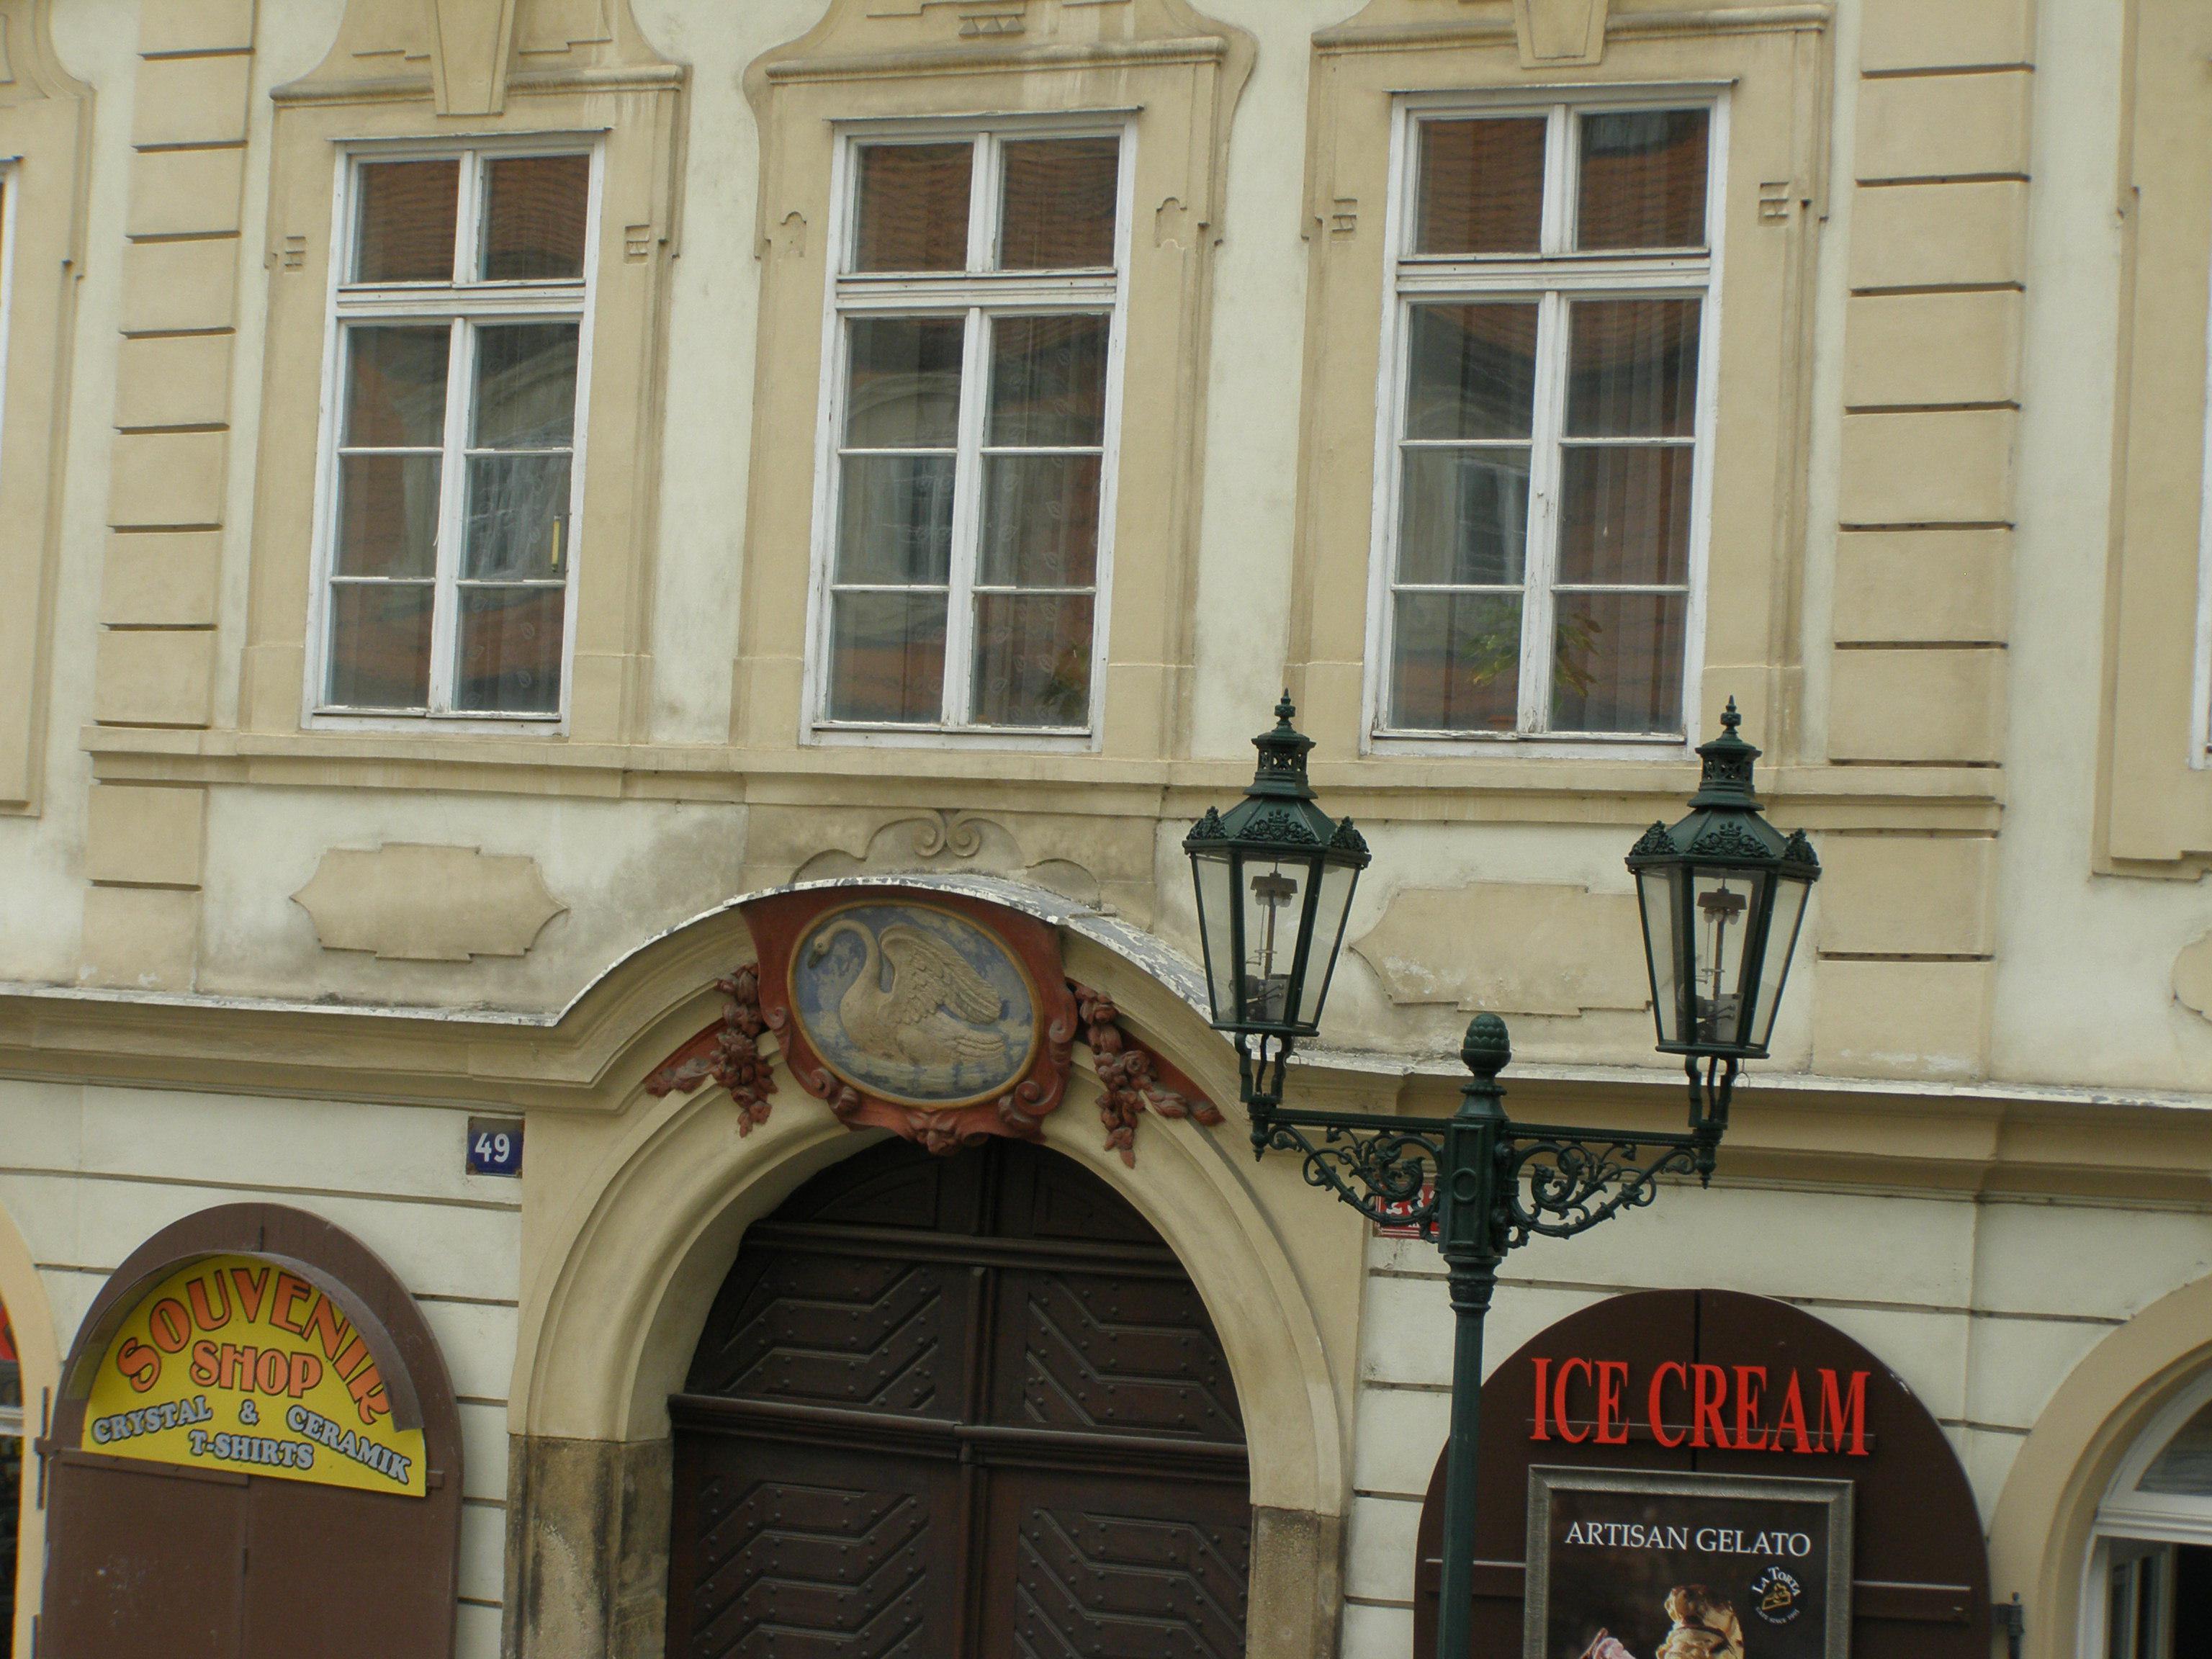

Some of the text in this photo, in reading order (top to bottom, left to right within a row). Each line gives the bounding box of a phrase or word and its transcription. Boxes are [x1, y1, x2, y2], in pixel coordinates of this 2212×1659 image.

[475, 1133, 510, 1163] 49
[117, 1267, 391, 1425] SOUVENIR
[189, 1339, 323, 1398] SHOP
[1529, 1357, 1871, 1456] ICE CREAM
[91, 1395, 412, 1485] CRYSTAL & CERAMIK
[189, 1429, 315, 1470] T-SHIRTS
[1565, 1521, 1812, 1557] ARTISAN GELATO
